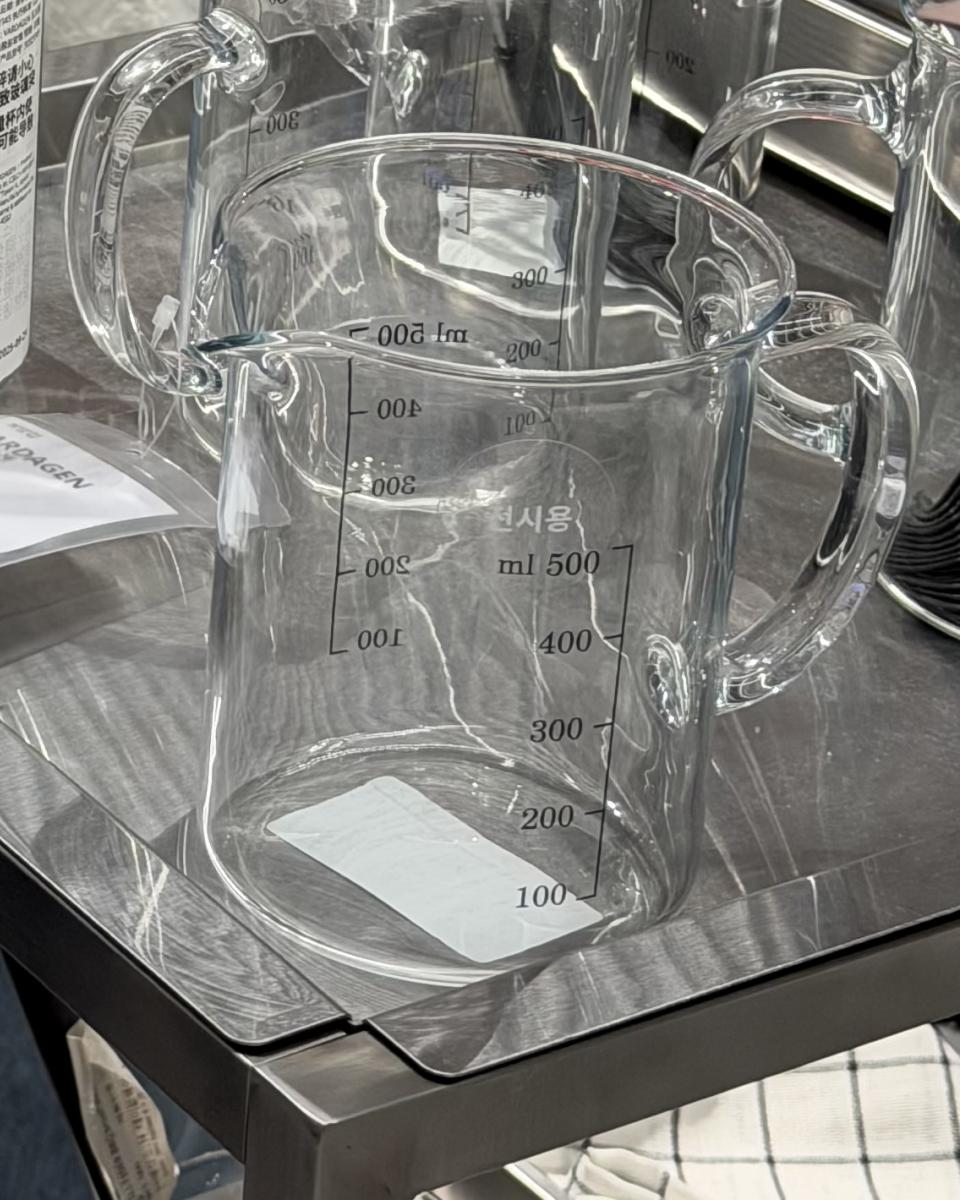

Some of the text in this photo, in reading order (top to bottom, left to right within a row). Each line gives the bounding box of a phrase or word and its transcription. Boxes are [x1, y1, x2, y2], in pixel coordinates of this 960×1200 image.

[505, 338, 542, 364] 200
[503, 410, 536, 436] 100
[498, 550, 601, 577] ml 500
[539, 629, 593, 655] 400
[529, 717, 584, 744] 300
[520, 804, 575, 831] 200
[515, 883, 568, 910] 100
